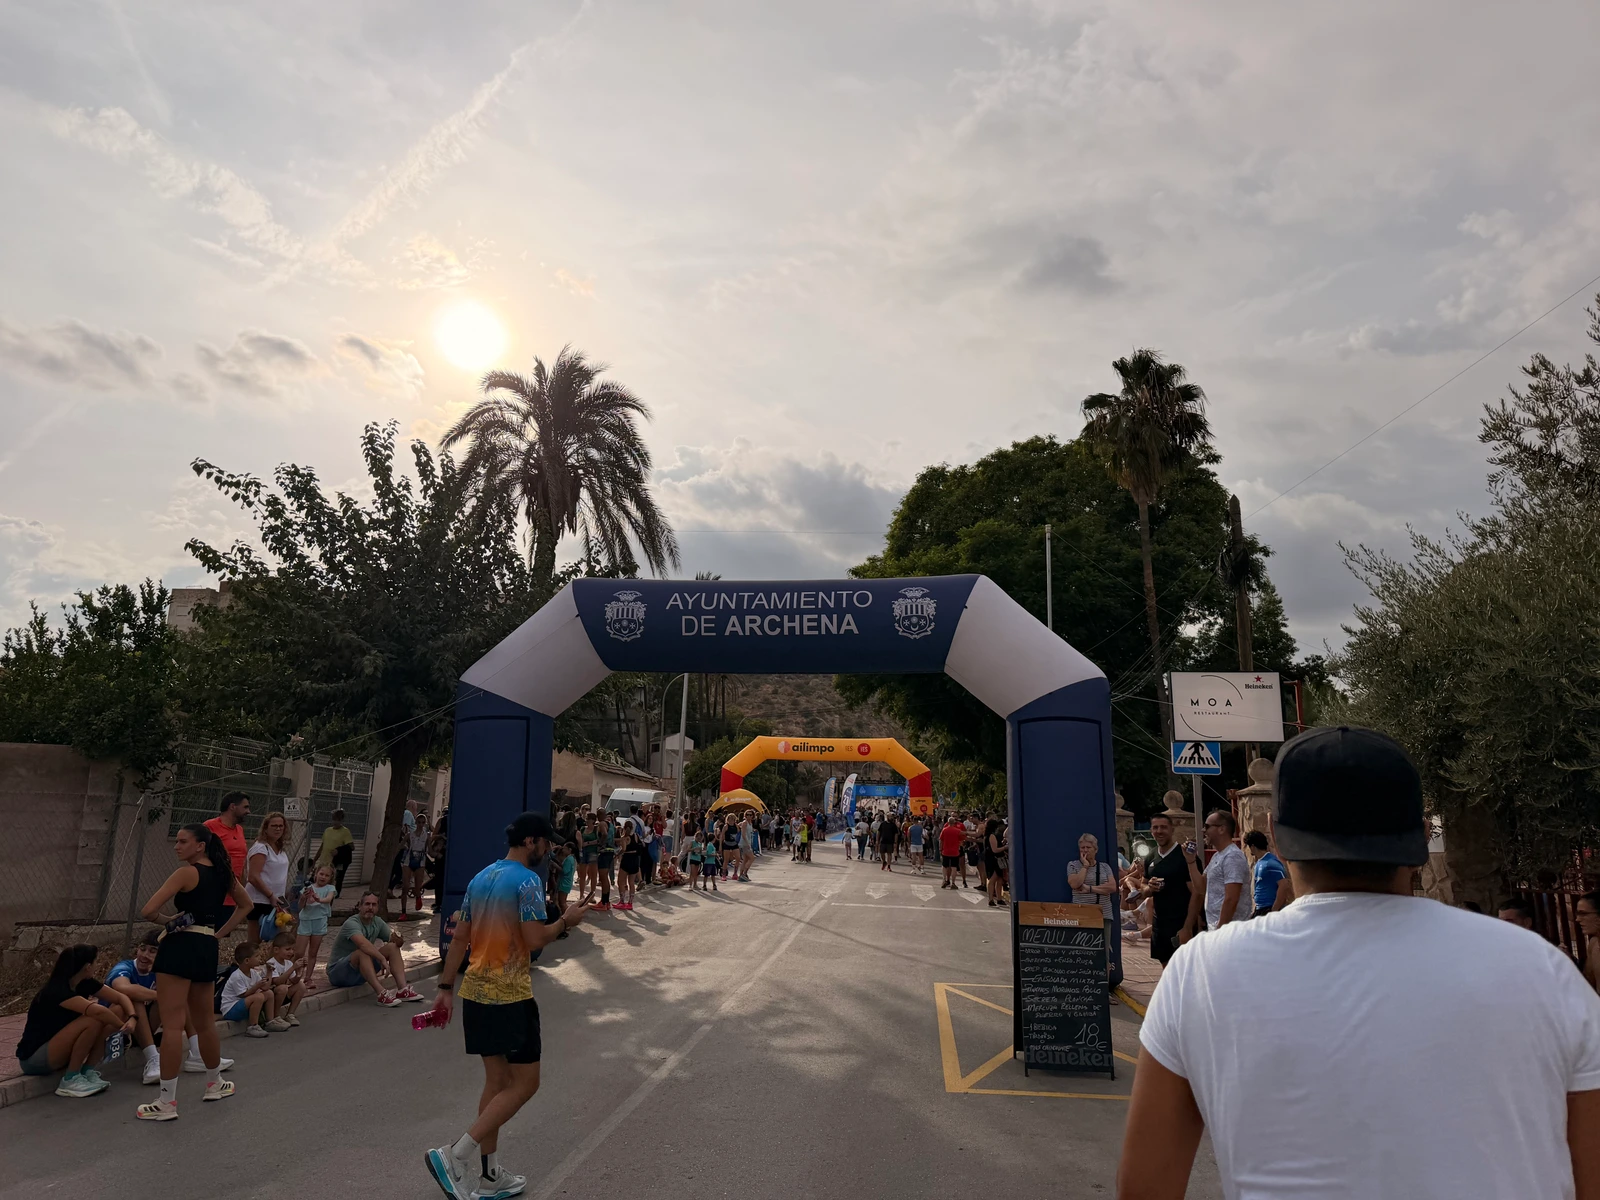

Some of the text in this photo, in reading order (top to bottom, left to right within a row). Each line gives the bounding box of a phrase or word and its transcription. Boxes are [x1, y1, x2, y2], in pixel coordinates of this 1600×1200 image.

[665, 590, 873, 610] AYUNTAMIENTO
[681, 613, 859, 636] DE ARCHENA
[791, 742, 835, 755] ailimpo
[1043, 917, 1080, 926] Heineken
[1022, 928, 1104, 949] MENU MOA
[111, 1032, 121, 1059] 1036
